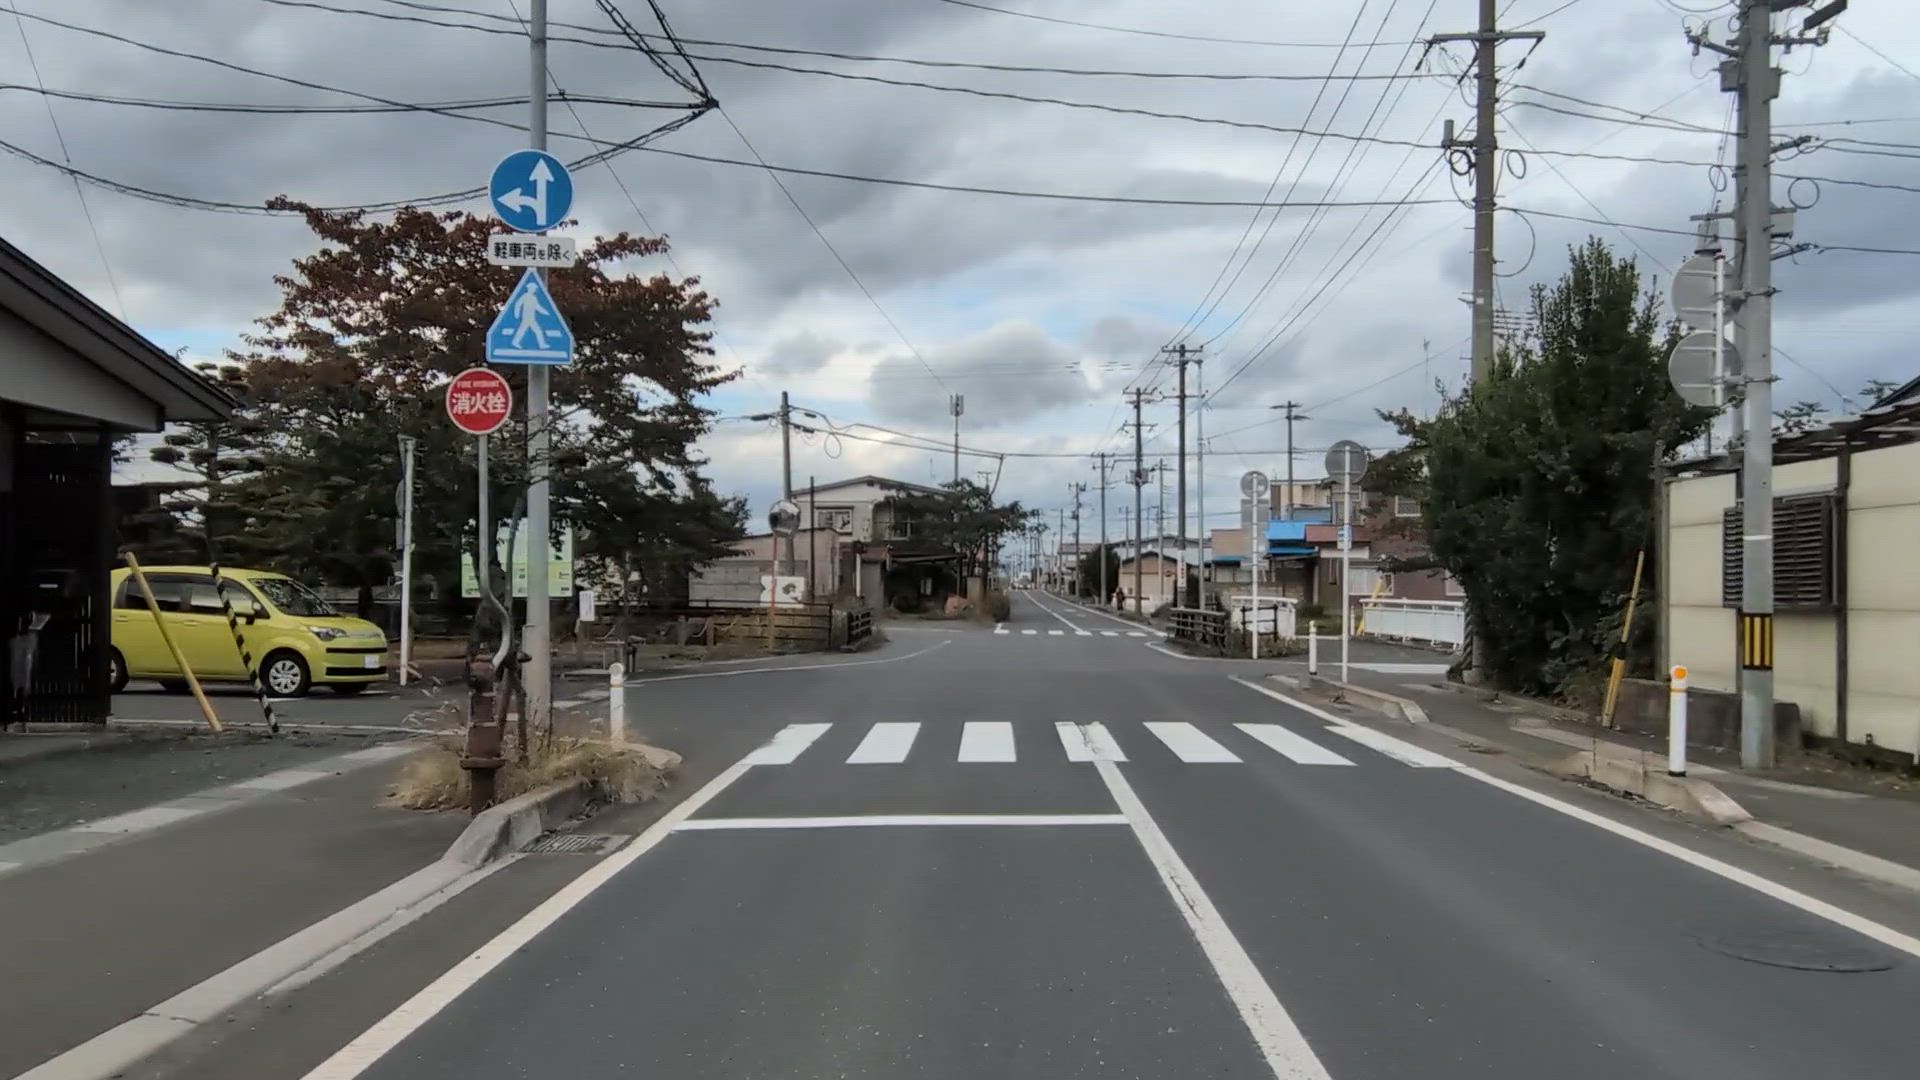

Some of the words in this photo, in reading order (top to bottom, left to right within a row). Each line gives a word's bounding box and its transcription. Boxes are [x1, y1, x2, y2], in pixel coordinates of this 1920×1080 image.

[494, 242, 569, 260] 軽車両を除く
[452, 391, 505, 414] 消火栓
